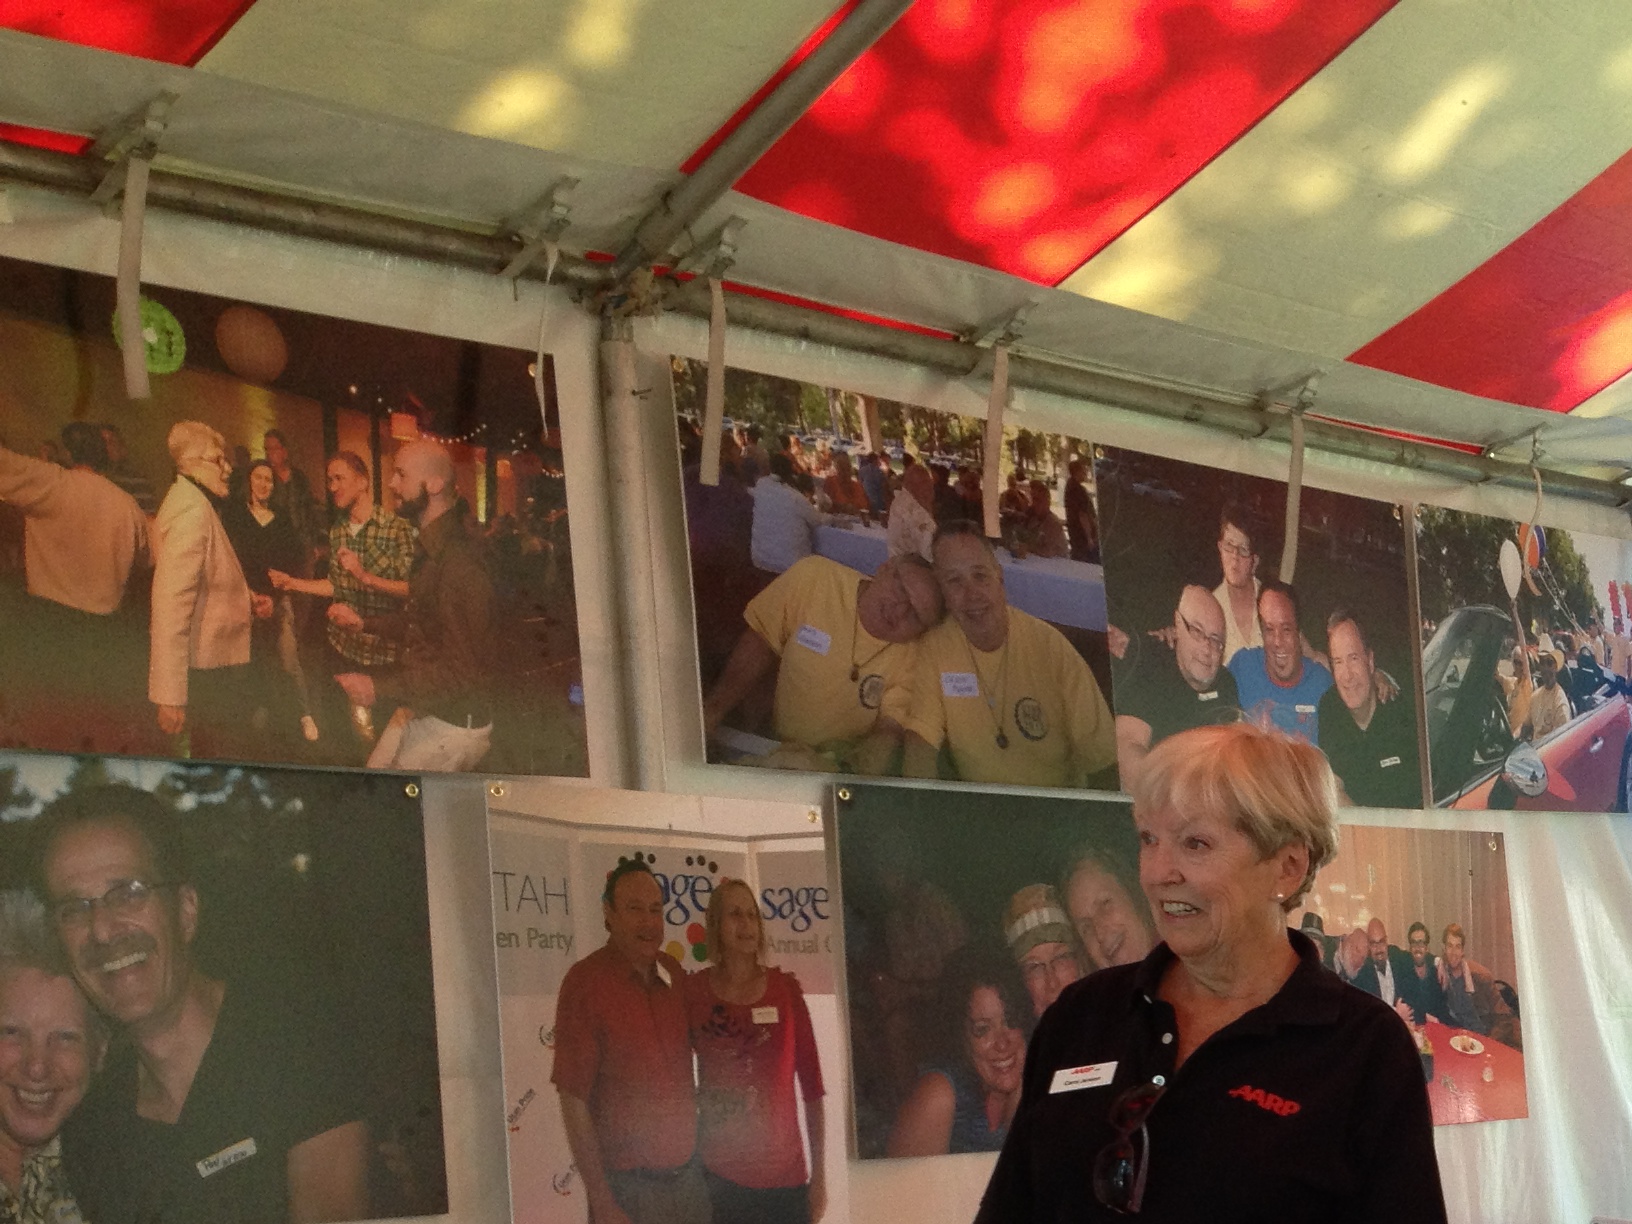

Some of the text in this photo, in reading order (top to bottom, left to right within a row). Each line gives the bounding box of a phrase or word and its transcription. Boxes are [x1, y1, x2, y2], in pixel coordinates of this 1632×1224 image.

[653, 873, 715, 926] age
[761, 886, 830, 932] sage
[527, 927, 574, 956] Party
[1228, 1085, 1301, 1116] AARP
